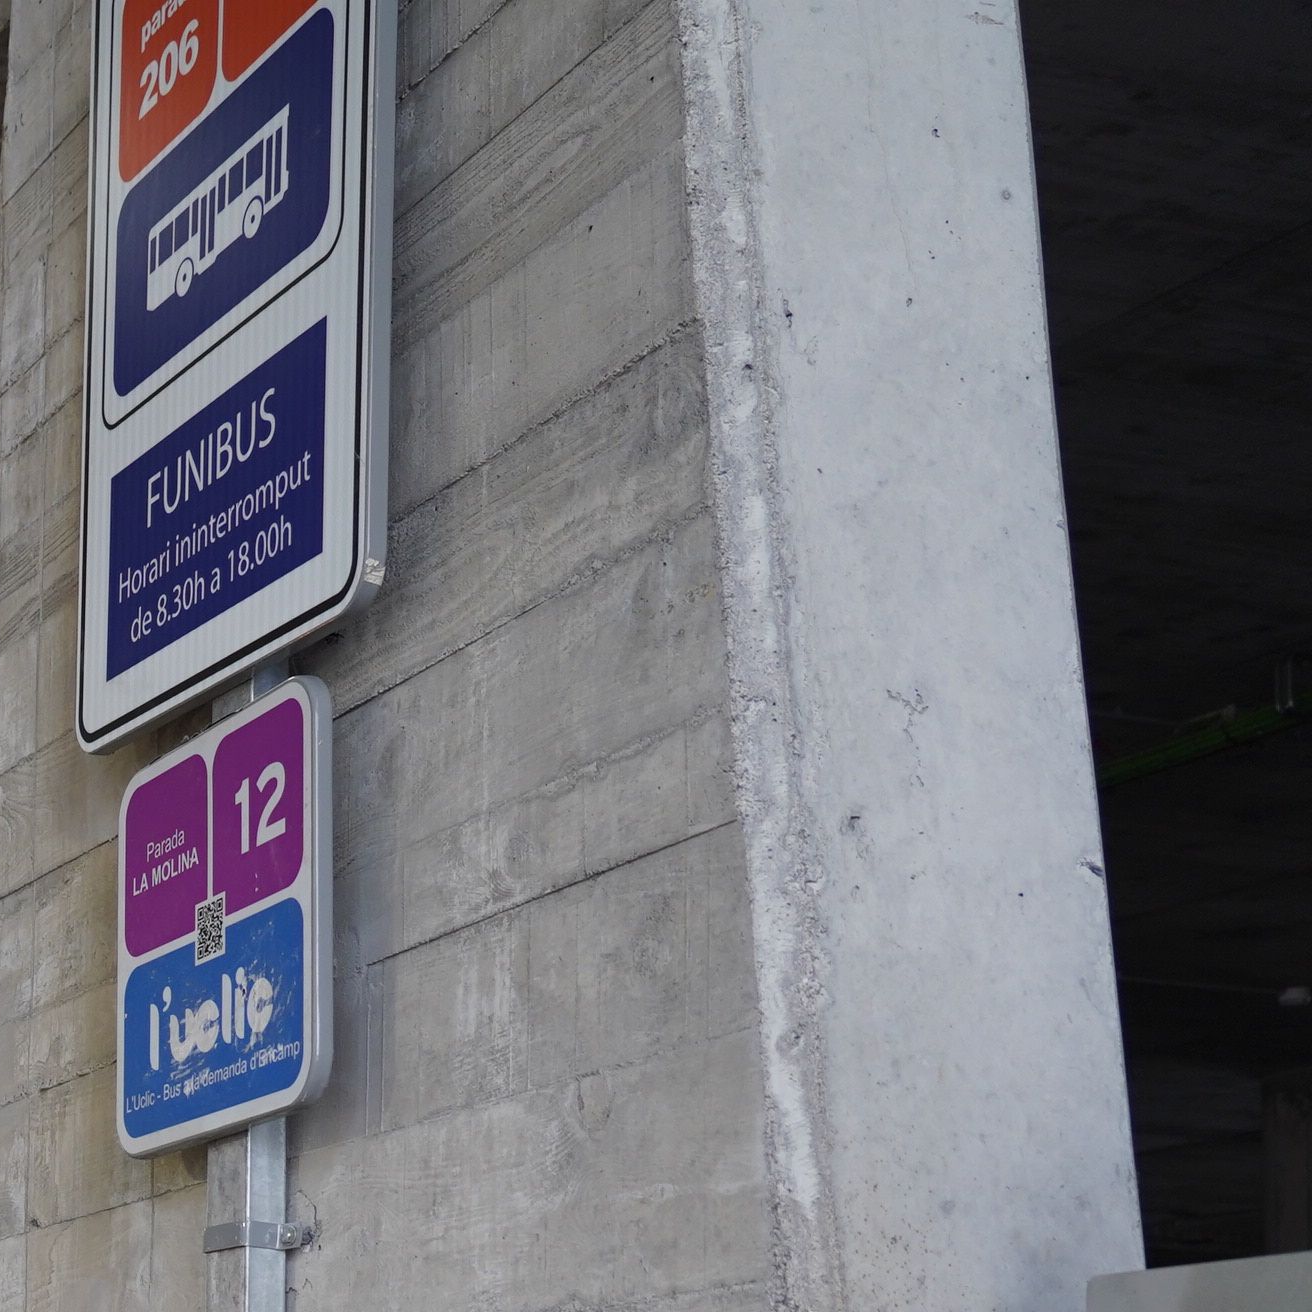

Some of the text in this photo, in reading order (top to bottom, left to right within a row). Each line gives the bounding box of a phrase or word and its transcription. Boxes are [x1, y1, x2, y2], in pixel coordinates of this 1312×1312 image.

[139, 19, 199, 120] 206
[146, 387, 276, 528] FUNIBUS
[118, 450, 312, 603] Horari ininterromput
[130, 515, 292, 643] de 8.30h a 18.00h
[146, 828, 185, 862] Parada
[235, 761, 286, 855] 12
[133, 846, 199, 896] LA MOLINA
[126, 1092, 155, 1113] L'Uclic
[163, 1082, 181, 1100] Bus
[201, 1060, 247, 1087] demanda
